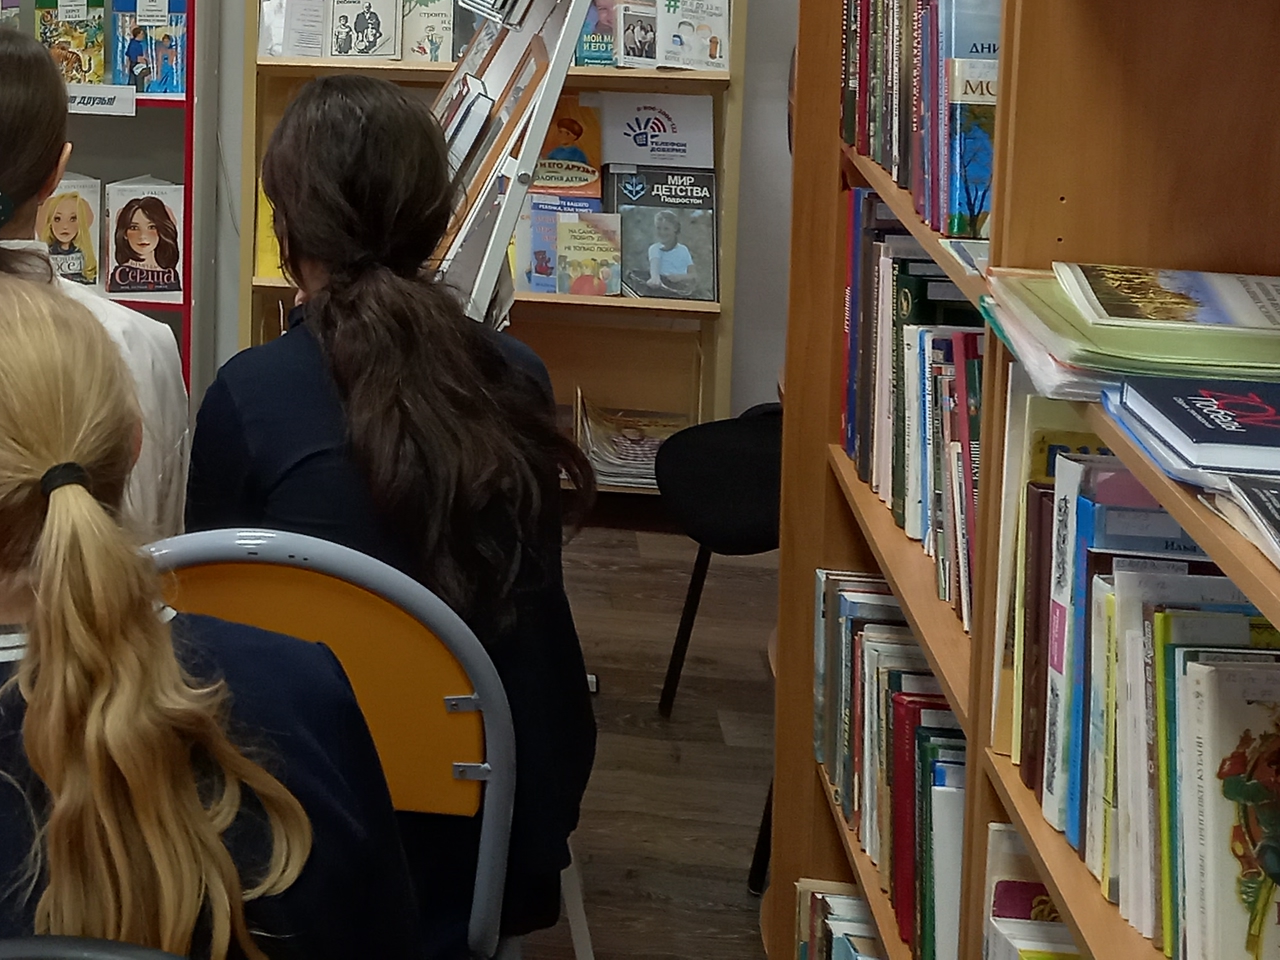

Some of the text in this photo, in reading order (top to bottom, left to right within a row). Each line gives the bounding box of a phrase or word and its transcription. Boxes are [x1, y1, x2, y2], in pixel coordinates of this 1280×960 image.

[583, 34, 602, 42] МОЙ
[591, 43, 607, 51] ЕГО
[77, 95, 116, 106] друзья!
[564, 163, 597, 175] ДРУЗЬЯ
[667, 175, 695, 185] МИР
[651, 184, 710, 197] ДЕТСТВА
[115, 267, 177, 285] Сердца
